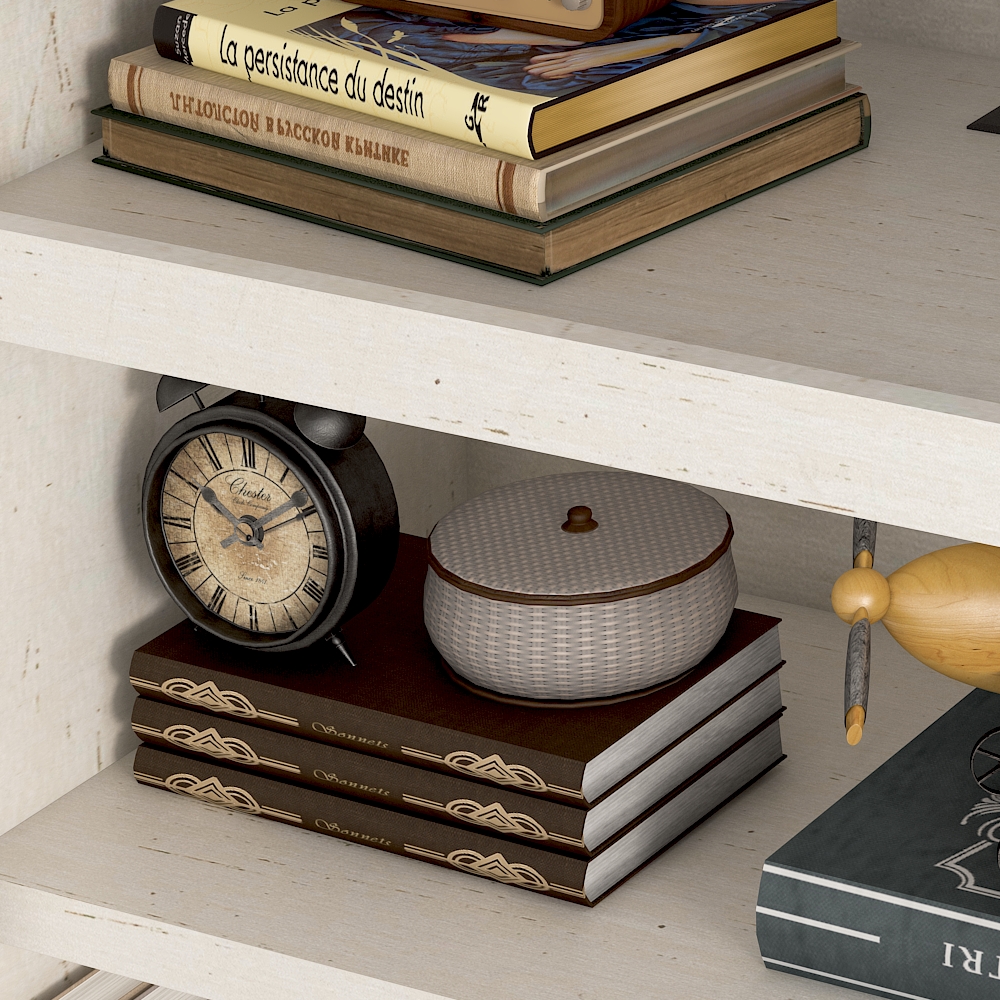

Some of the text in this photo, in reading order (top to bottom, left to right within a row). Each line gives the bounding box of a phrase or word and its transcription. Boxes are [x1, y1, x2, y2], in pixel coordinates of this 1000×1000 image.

[263, 6, 299, 17] La
[219, 24, 425, 119] La persistance du destin
[225, 475, 272, 502] Chester
[311, 721, 389, 750] Sonnets
[313, 769, 391, 797] Sonnets
[315, 818, 392, 846] Sonnets
